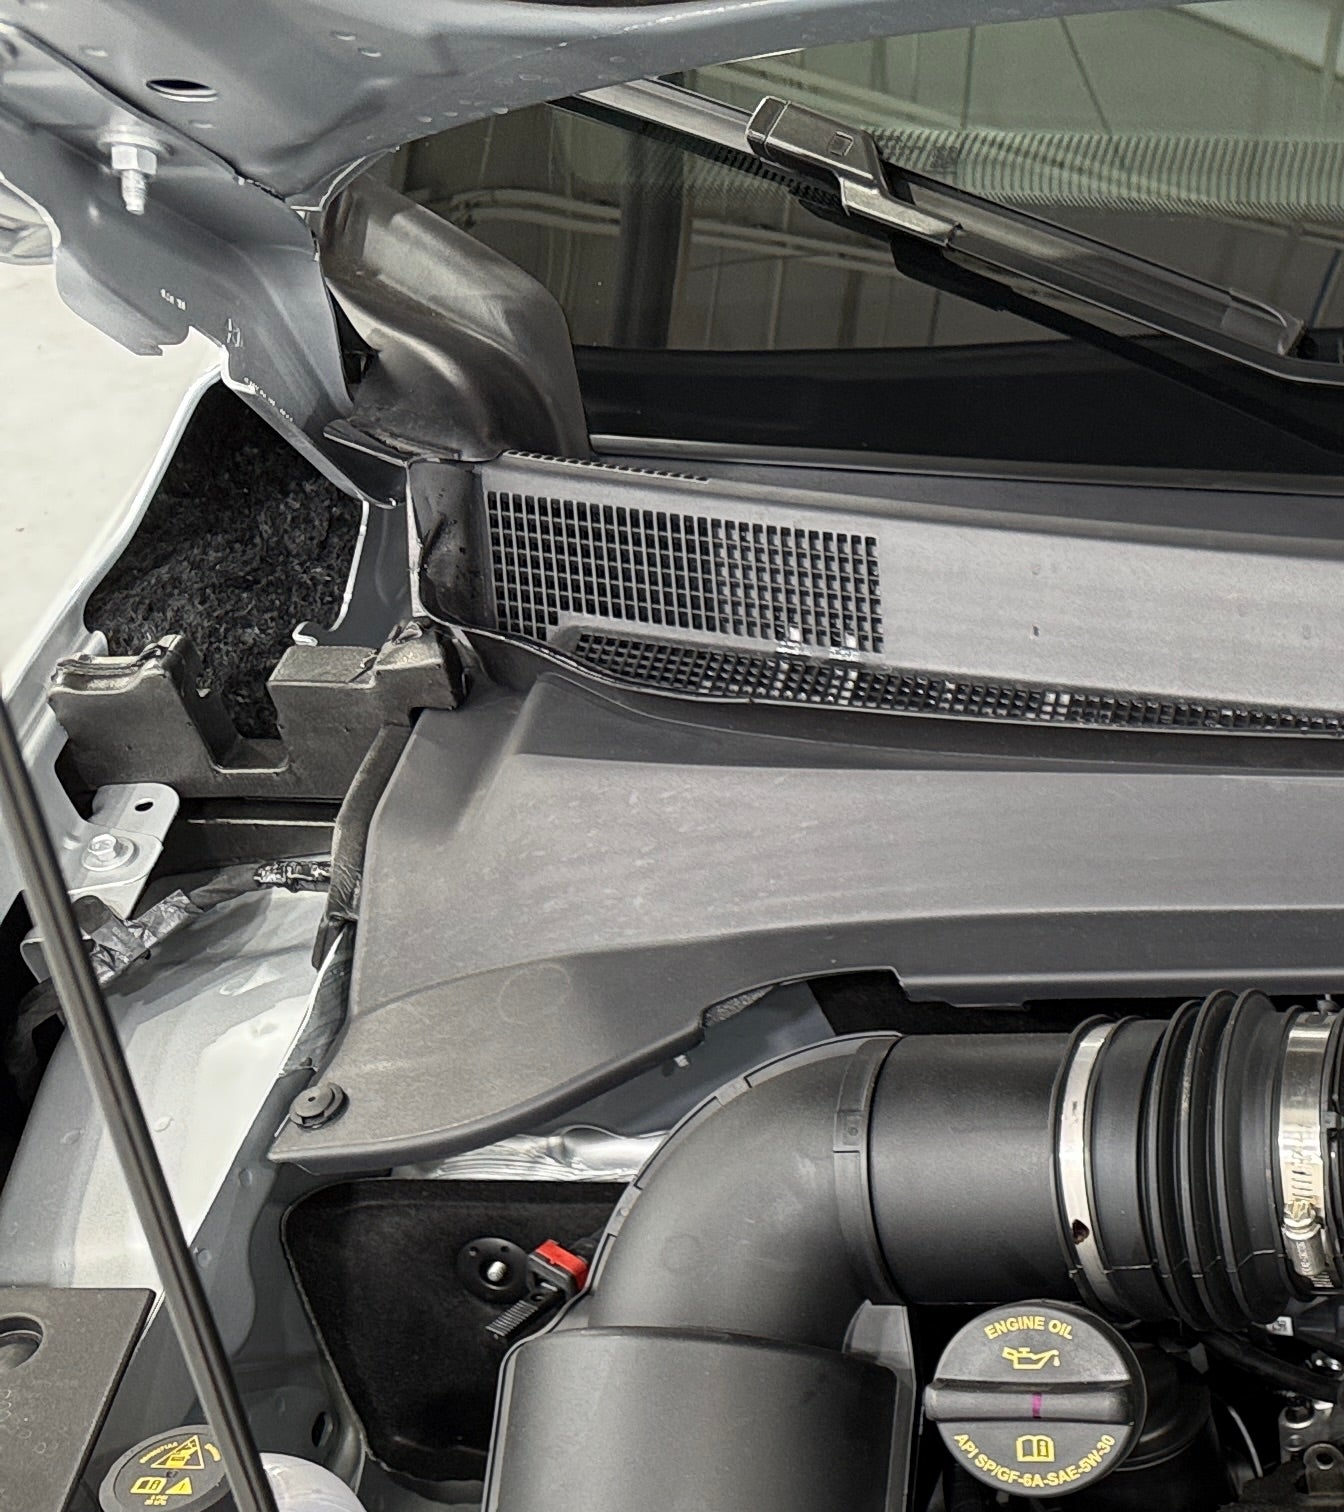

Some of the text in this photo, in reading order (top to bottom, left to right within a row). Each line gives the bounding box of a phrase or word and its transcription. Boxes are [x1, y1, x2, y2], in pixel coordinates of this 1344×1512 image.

[984, 1317, 1073, 1340] ENGINE OIL
[954, 1433, 978, 1459] API
